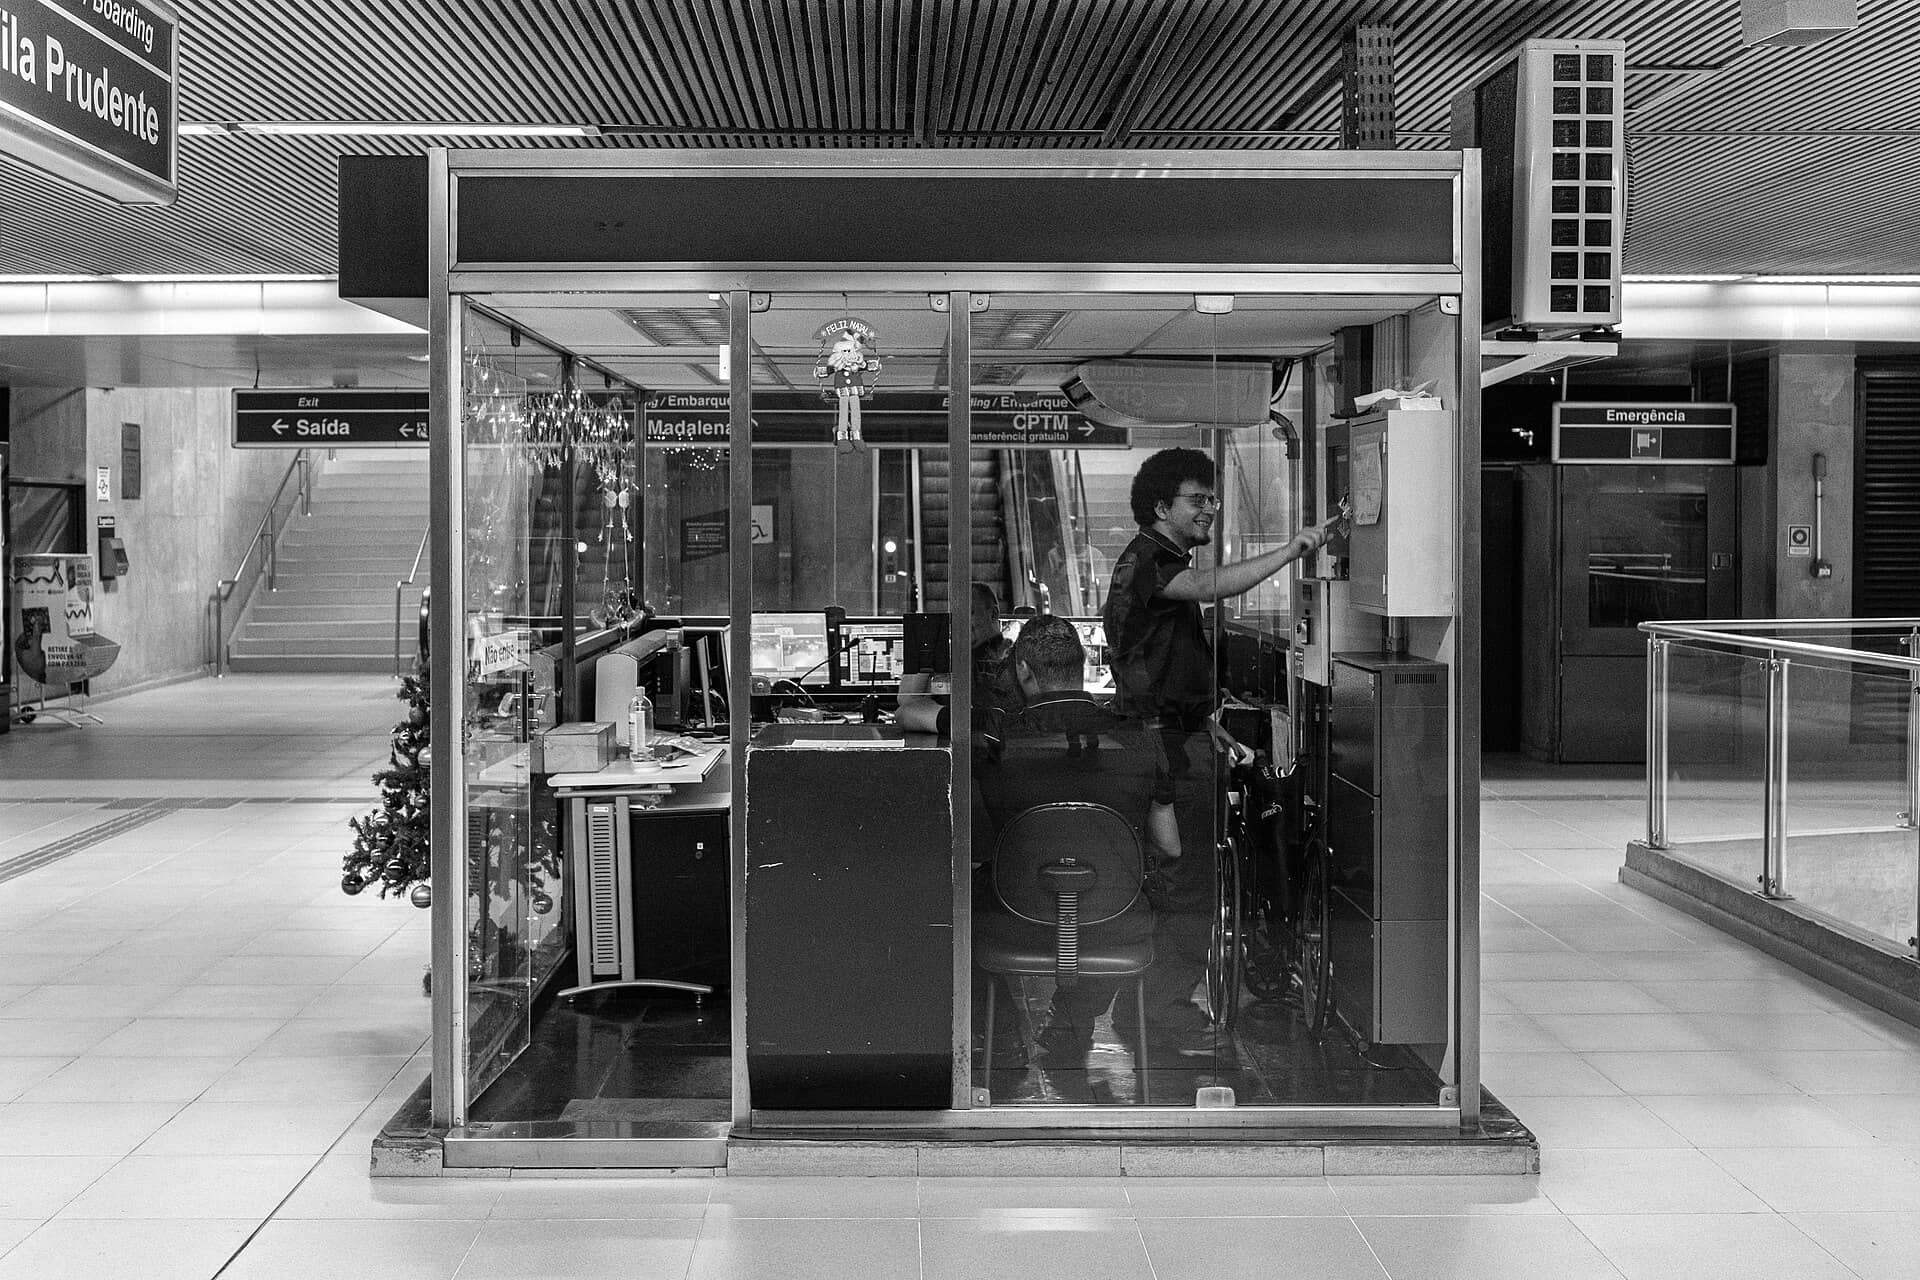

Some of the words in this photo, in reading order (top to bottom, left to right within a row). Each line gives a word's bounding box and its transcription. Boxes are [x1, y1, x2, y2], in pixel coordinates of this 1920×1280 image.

[0, 7, 36, 85] ila
[46, 34, 159, 145] Prudente
[825, 320, 848, 336] FELIZ
[849, 320, 869, 336] NATAL
[298, 397, 319, 407] Exit
[668, 395, 730, 408] Embarqu
[1013, 415, 1068, 430] CPTM
[1606, 409, 1685, 424] Emergência
[297, 418, 350, 435] Saída
